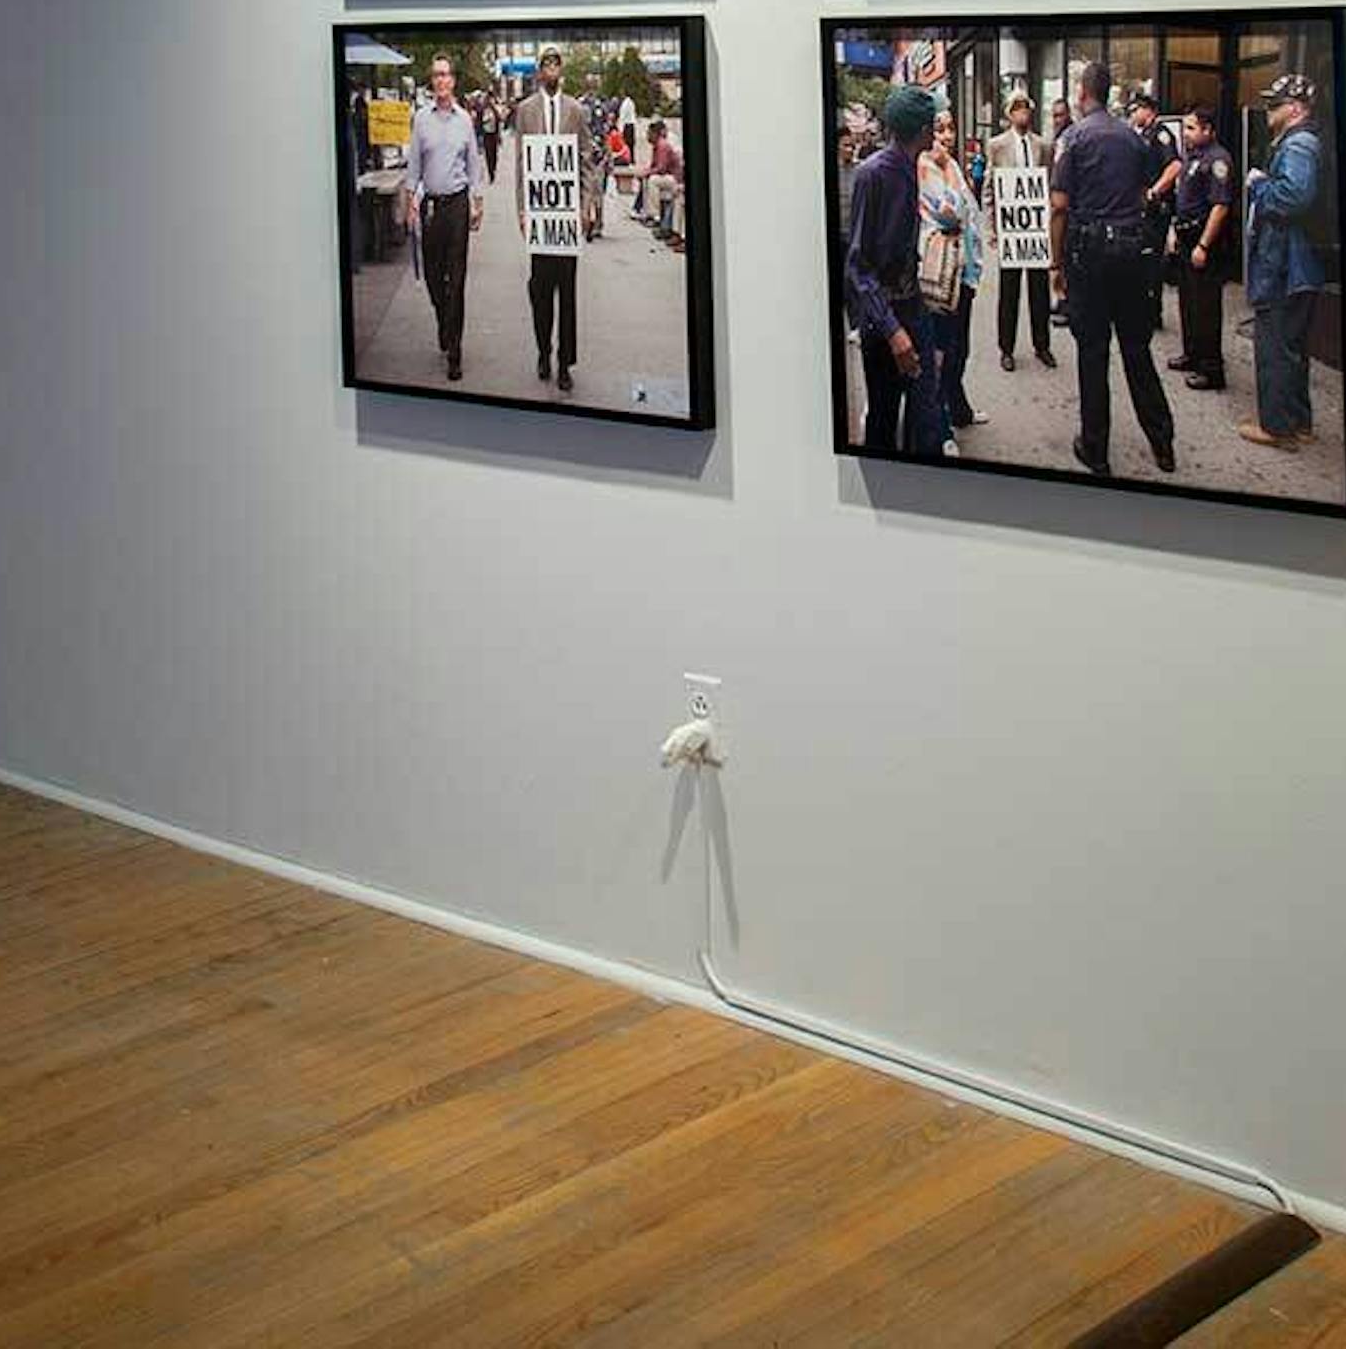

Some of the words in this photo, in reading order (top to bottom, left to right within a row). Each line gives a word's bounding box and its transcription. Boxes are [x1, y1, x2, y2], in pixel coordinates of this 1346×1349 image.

[527, 145, 532, 171] I
[543, 145, 574, 171] AM
[529, 180, 574, 206] NOT
[998, 177, 1003, 198] I
[1015, 177, 1044, 199] AM
[1000, 206, 1045, 229] NOT
[530, 219, 539, 244] A
[544, 219, 577, 246] MAN
[1003, 238, 1013, 260] A
[1016, 238, 1049, 260] MAN
